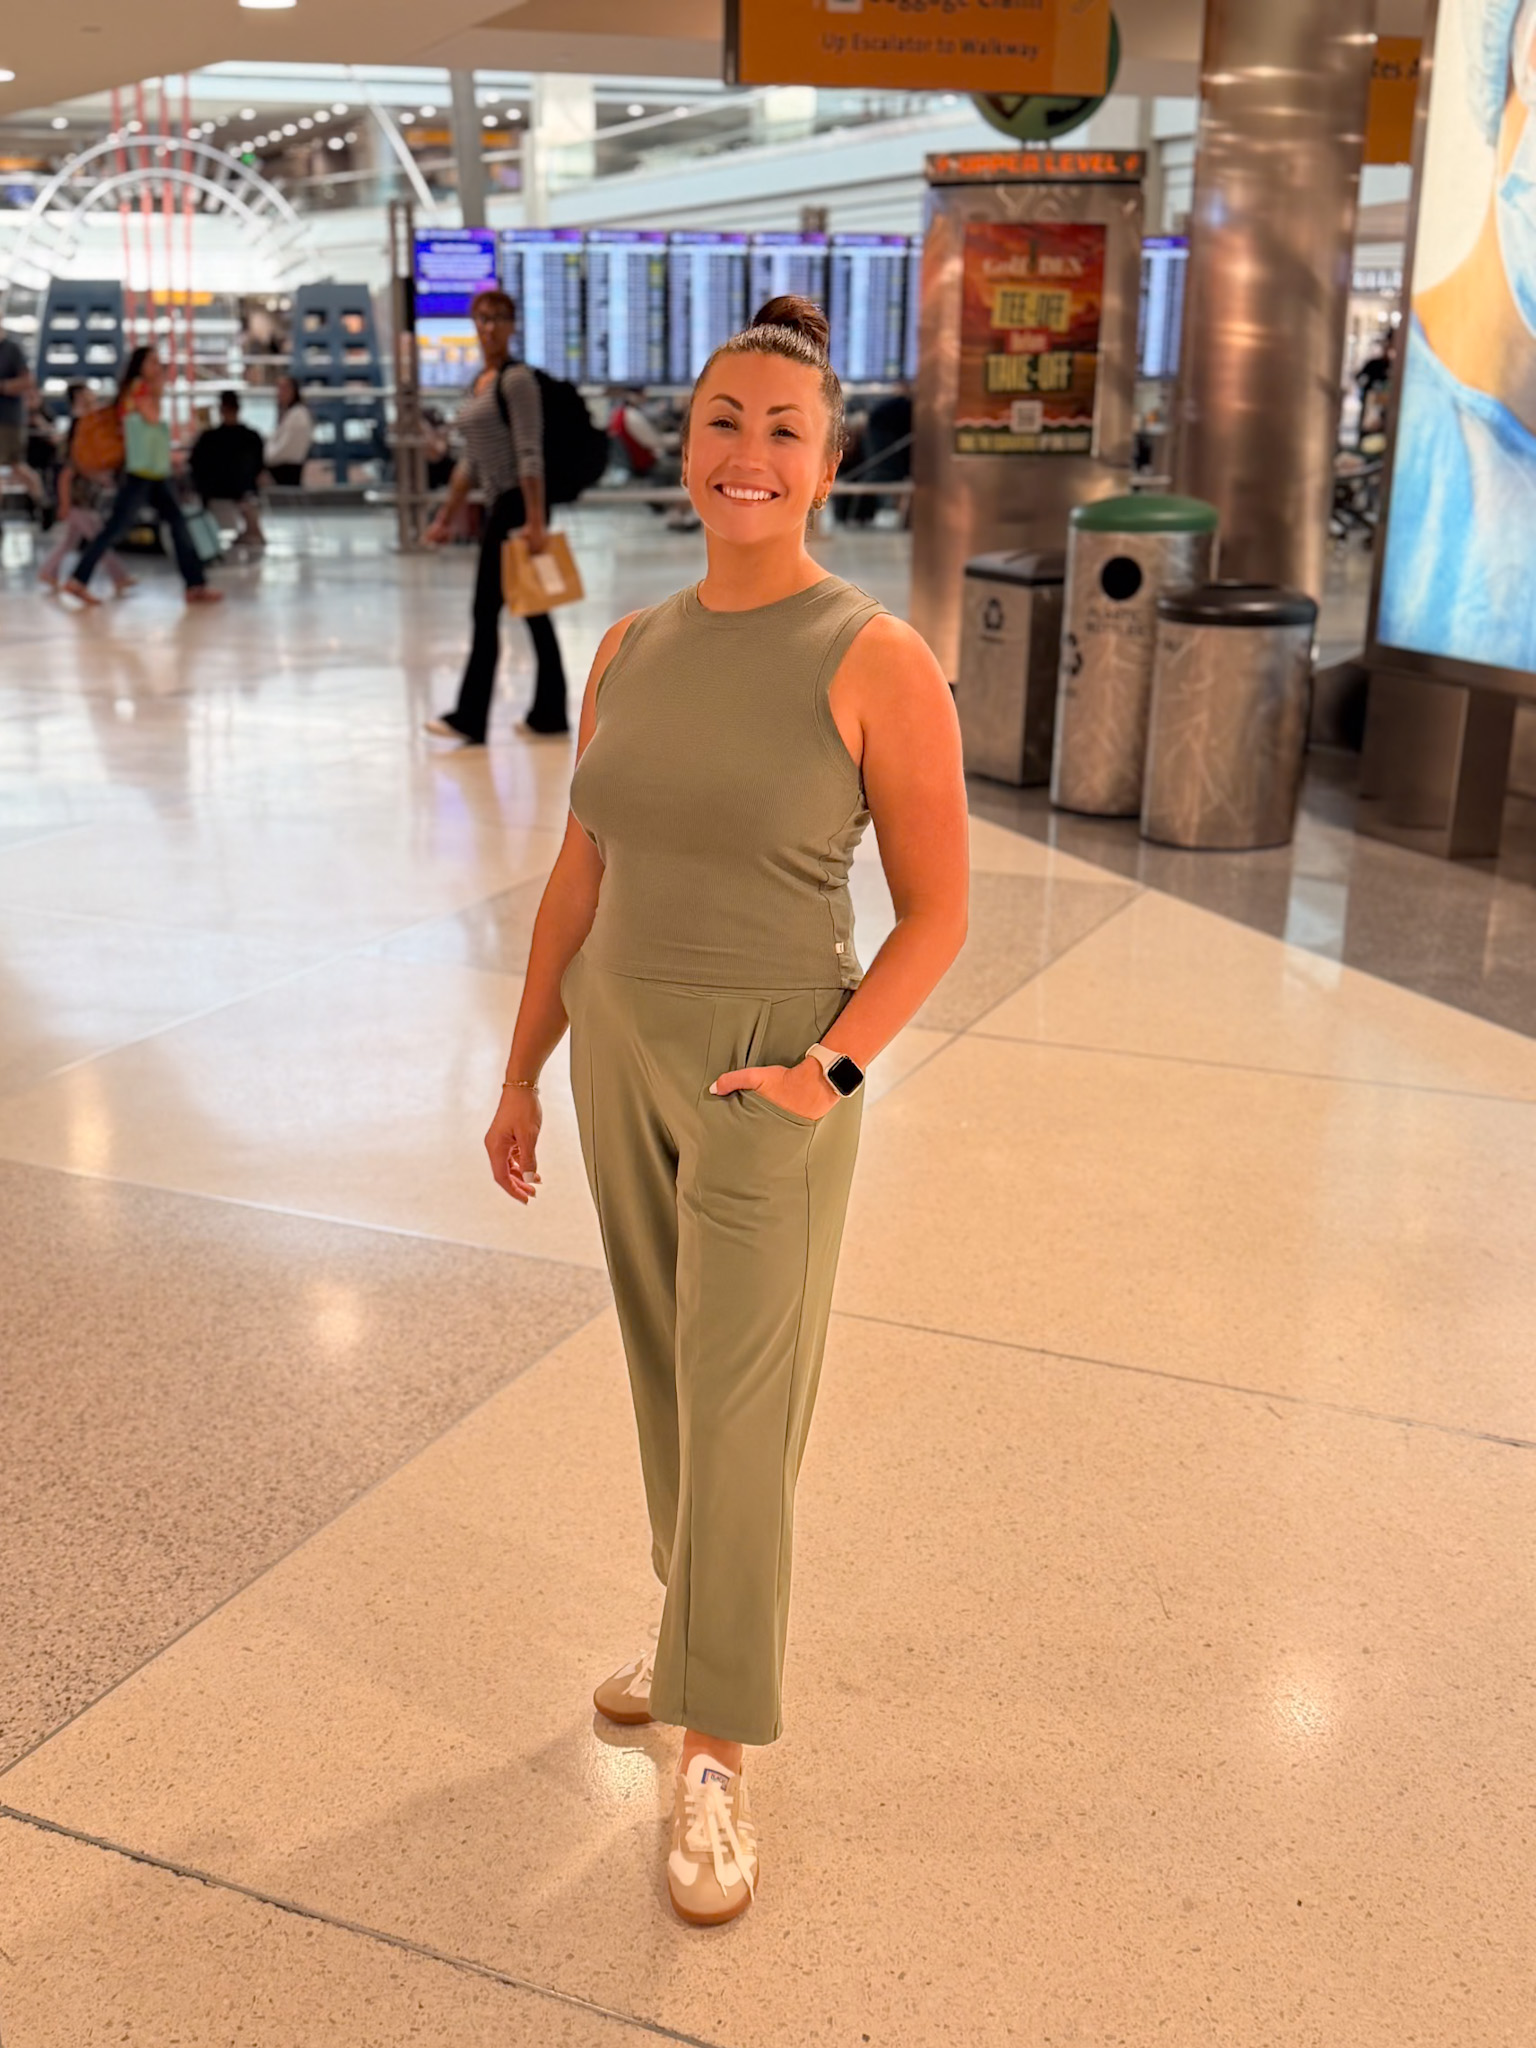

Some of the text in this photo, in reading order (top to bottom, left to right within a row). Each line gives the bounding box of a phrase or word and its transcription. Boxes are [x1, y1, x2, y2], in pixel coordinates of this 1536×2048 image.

[821, 32, 1039, 62] Up Escalator to Walkway
[958, 153, 1120, 174] UPPER LEVEL
